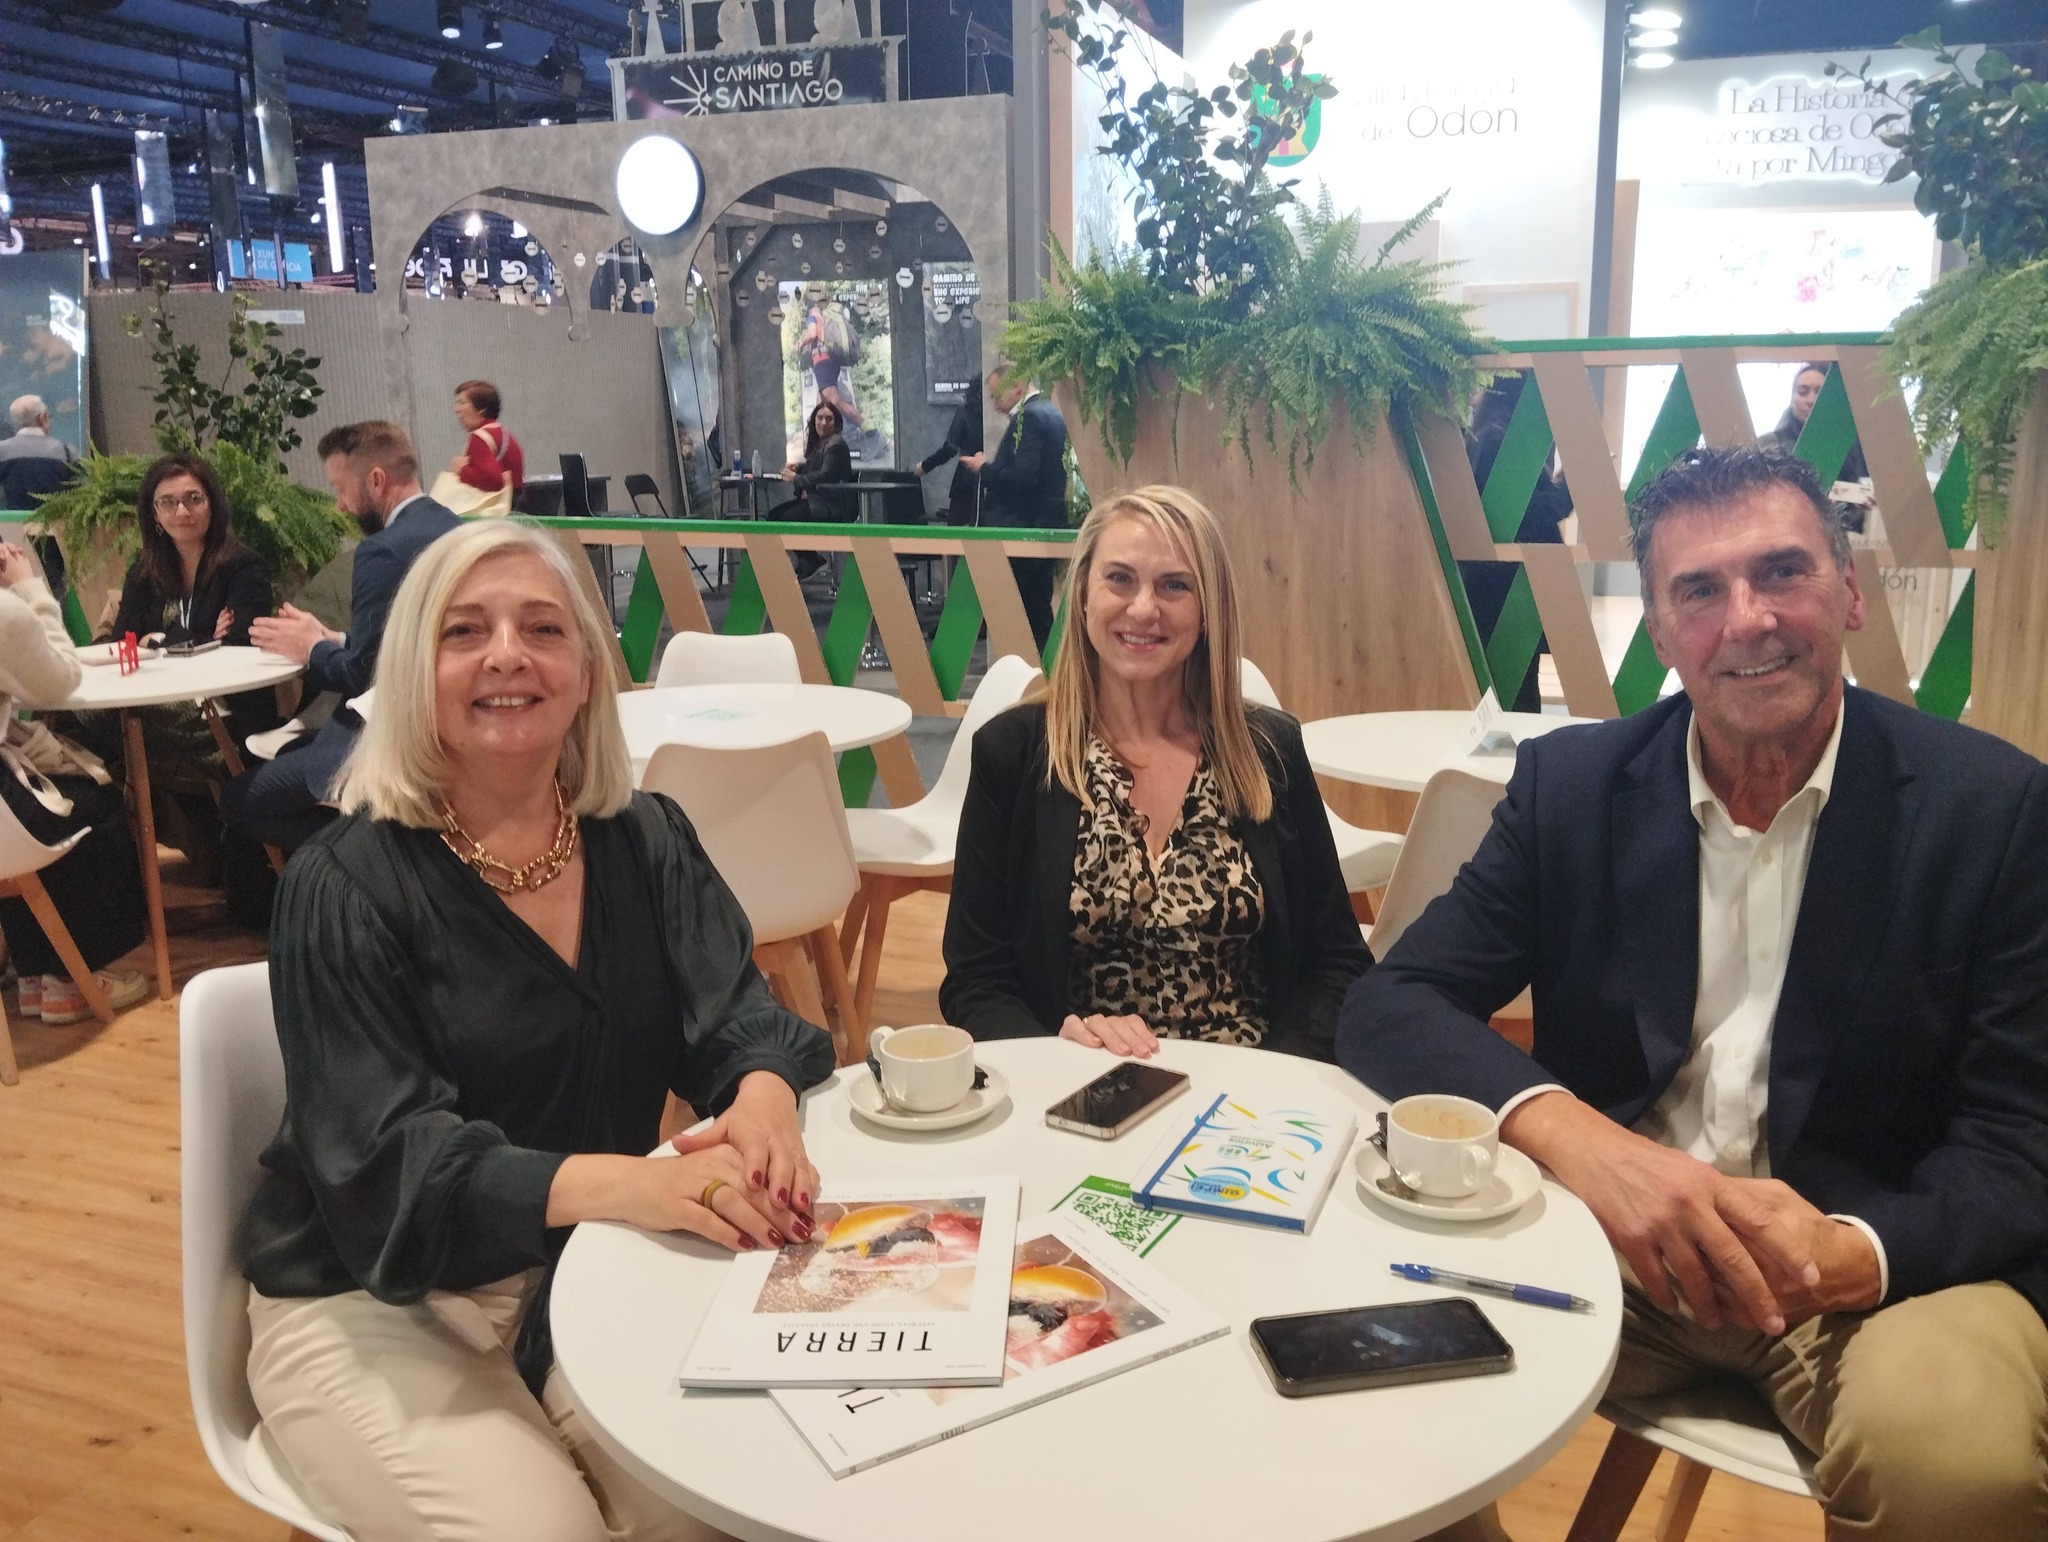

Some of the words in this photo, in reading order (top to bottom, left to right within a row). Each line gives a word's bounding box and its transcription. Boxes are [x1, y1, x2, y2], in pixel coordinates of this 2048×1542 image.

[714, 62, 783, 82] CAMINO
[790, 60, 814, 78] DE
[715, 78, 843, 109] SANTIAGO
[1730, 88, 1768, 114] La
[1775, 85, 1889, 112] Historia
[1809, 115, 1842, 142] de
[1752, 157, 1798, 180] por
[1806, 145, 1901, 177] Mingo
[778, 1331, 933, 1353] TIERRA
[940, 1424, 966, 1441] TIERRA
